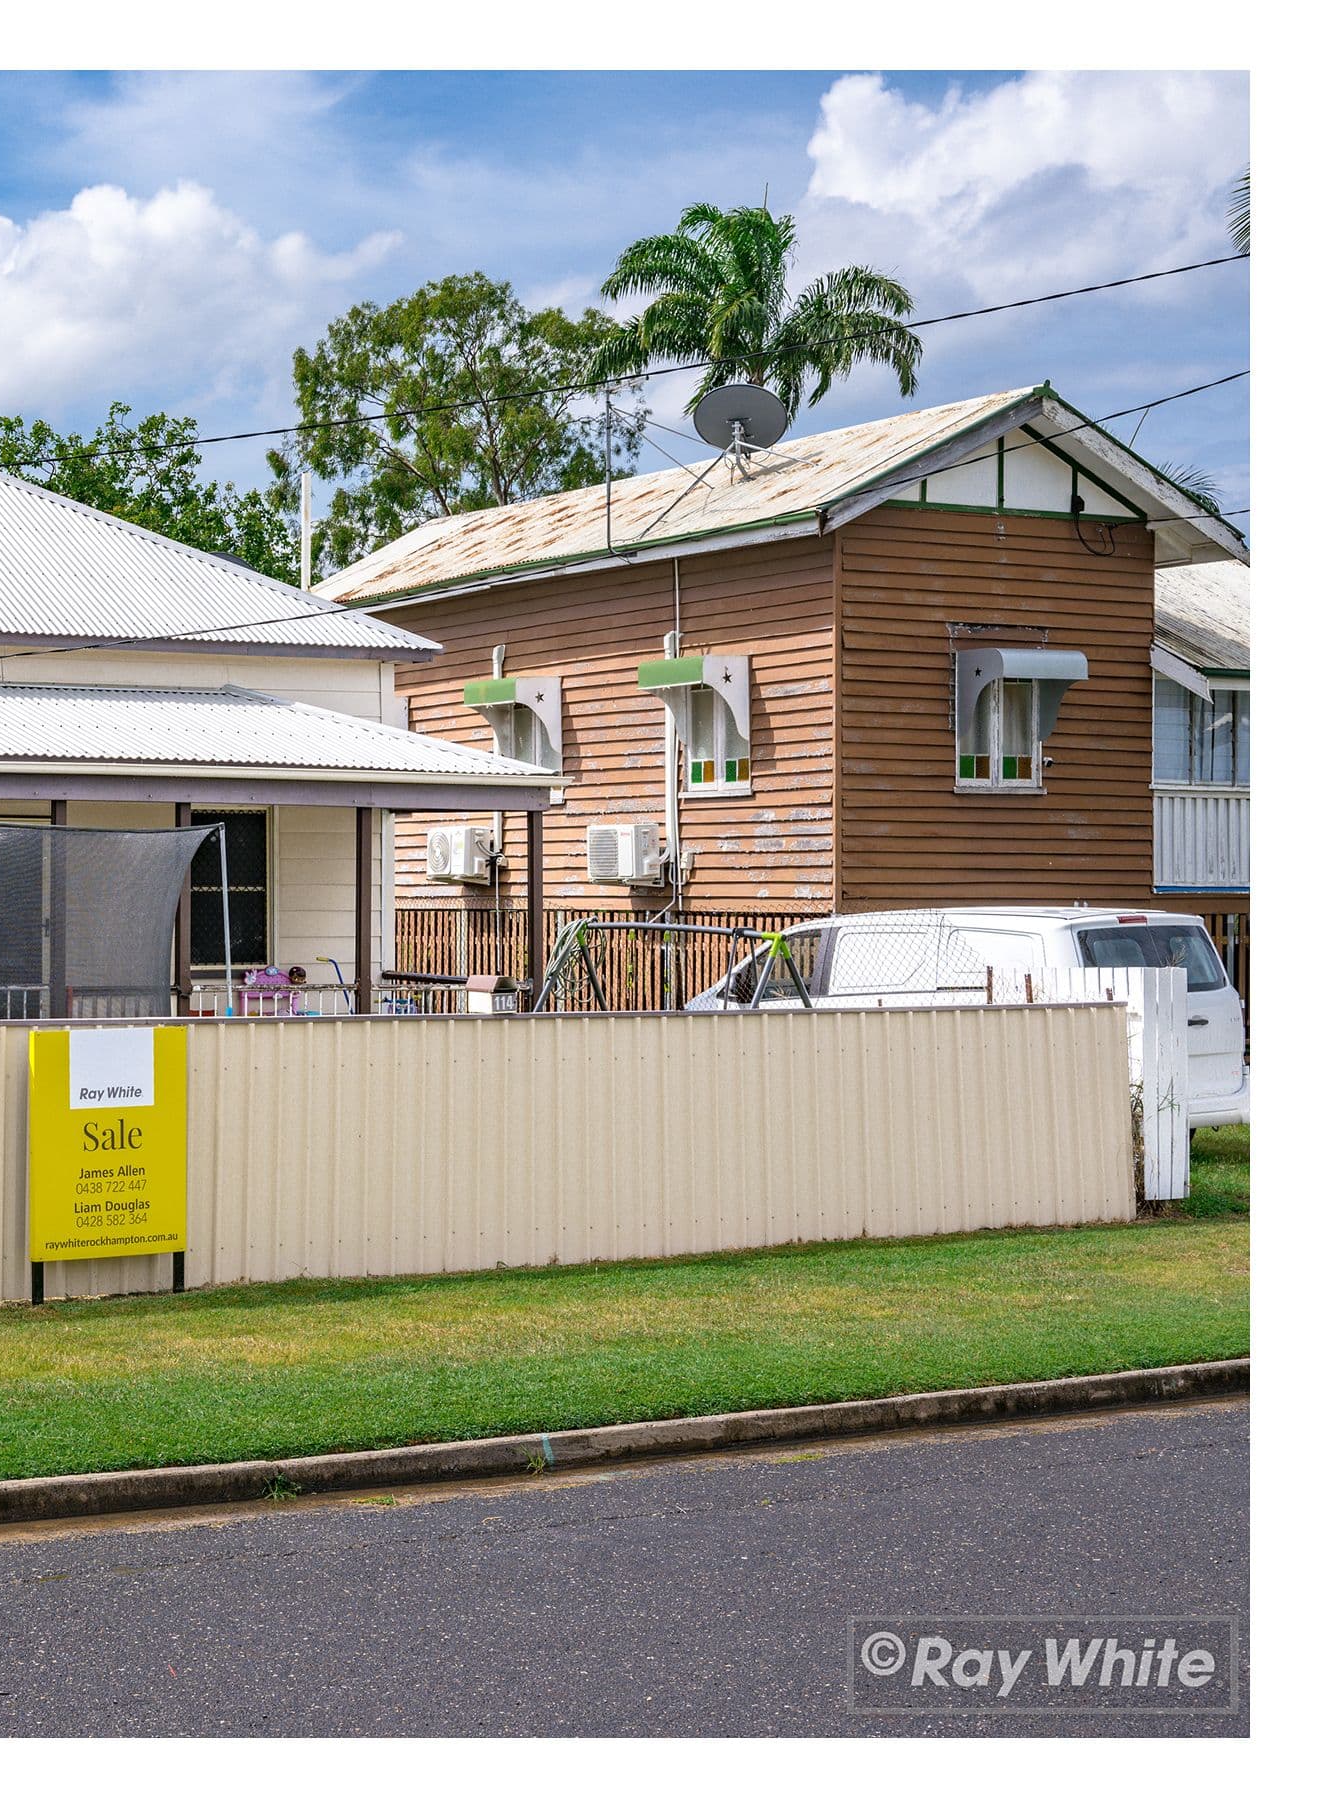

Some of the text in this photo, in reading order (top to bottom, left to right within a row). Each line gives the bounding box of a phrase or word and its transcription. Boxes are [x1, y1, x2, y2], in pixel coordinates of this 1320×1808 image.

[494, 996, 514, 1010] 114
[79, 1086, 143, 1102] Ray White
[83, 1118, 143, 1152] Sale
[78, 1165, 146, 1179] James Allen
[75, 1179, 147, 1195] 0438 722 447
[74, 1199, 151, 1214] Liam Douglas
[76, 1213, 148, 1229] 0428 582 364
[45, 1233, 178, 1250] raywhiterockhampton.com.au
